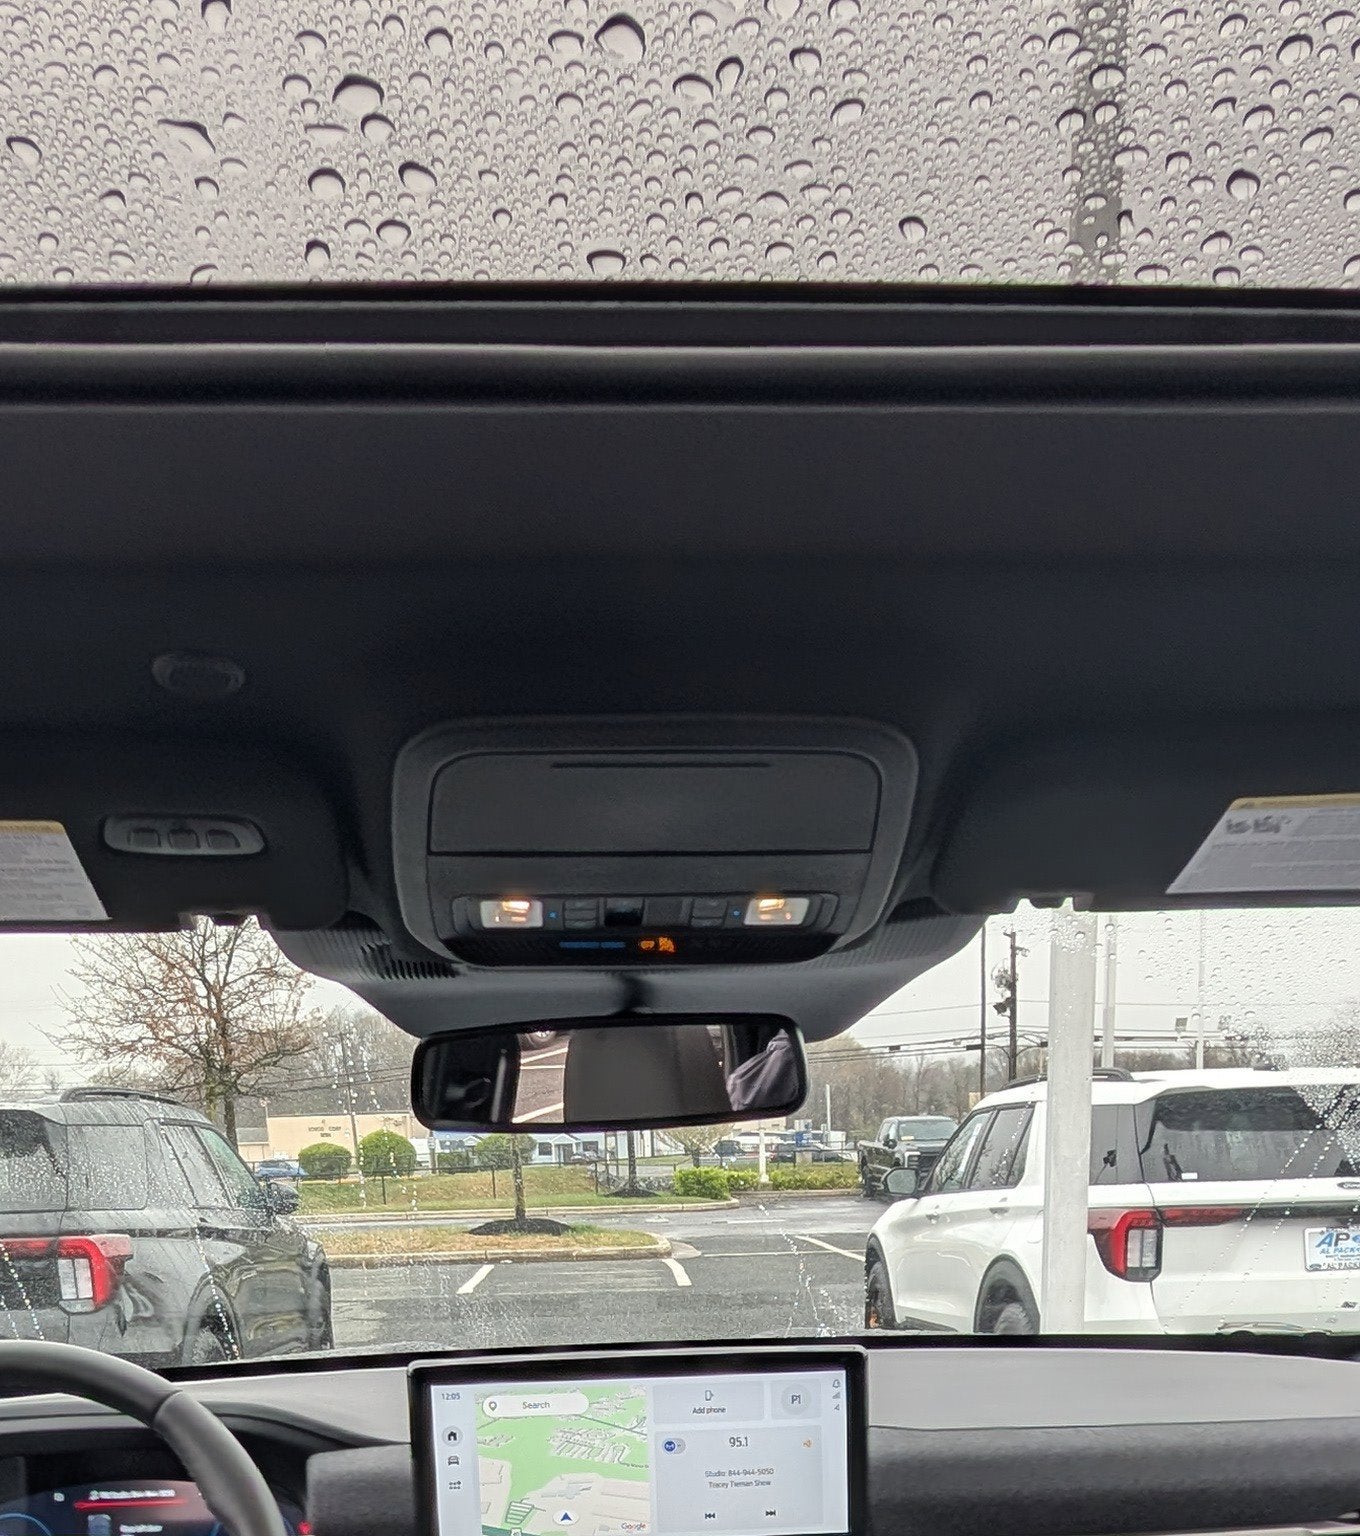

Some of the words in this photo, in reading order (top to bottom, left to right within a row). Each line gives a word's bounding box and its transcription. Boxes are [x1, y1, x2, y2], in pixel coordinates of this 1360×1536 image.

[1315, 1232, 1351, 1248] AP
[441, 1392, 461, 1400] 12:05
[791, 1395, 801, 1404] P1
[522, 1401, 550, 1410] Search
[706, 1406, 726, 1415] phone
[729, 1436, 749, 1447] 95.1
[709, 1481, 729, 1489] Tracey
[621, 1521, 646, 1532] Google
